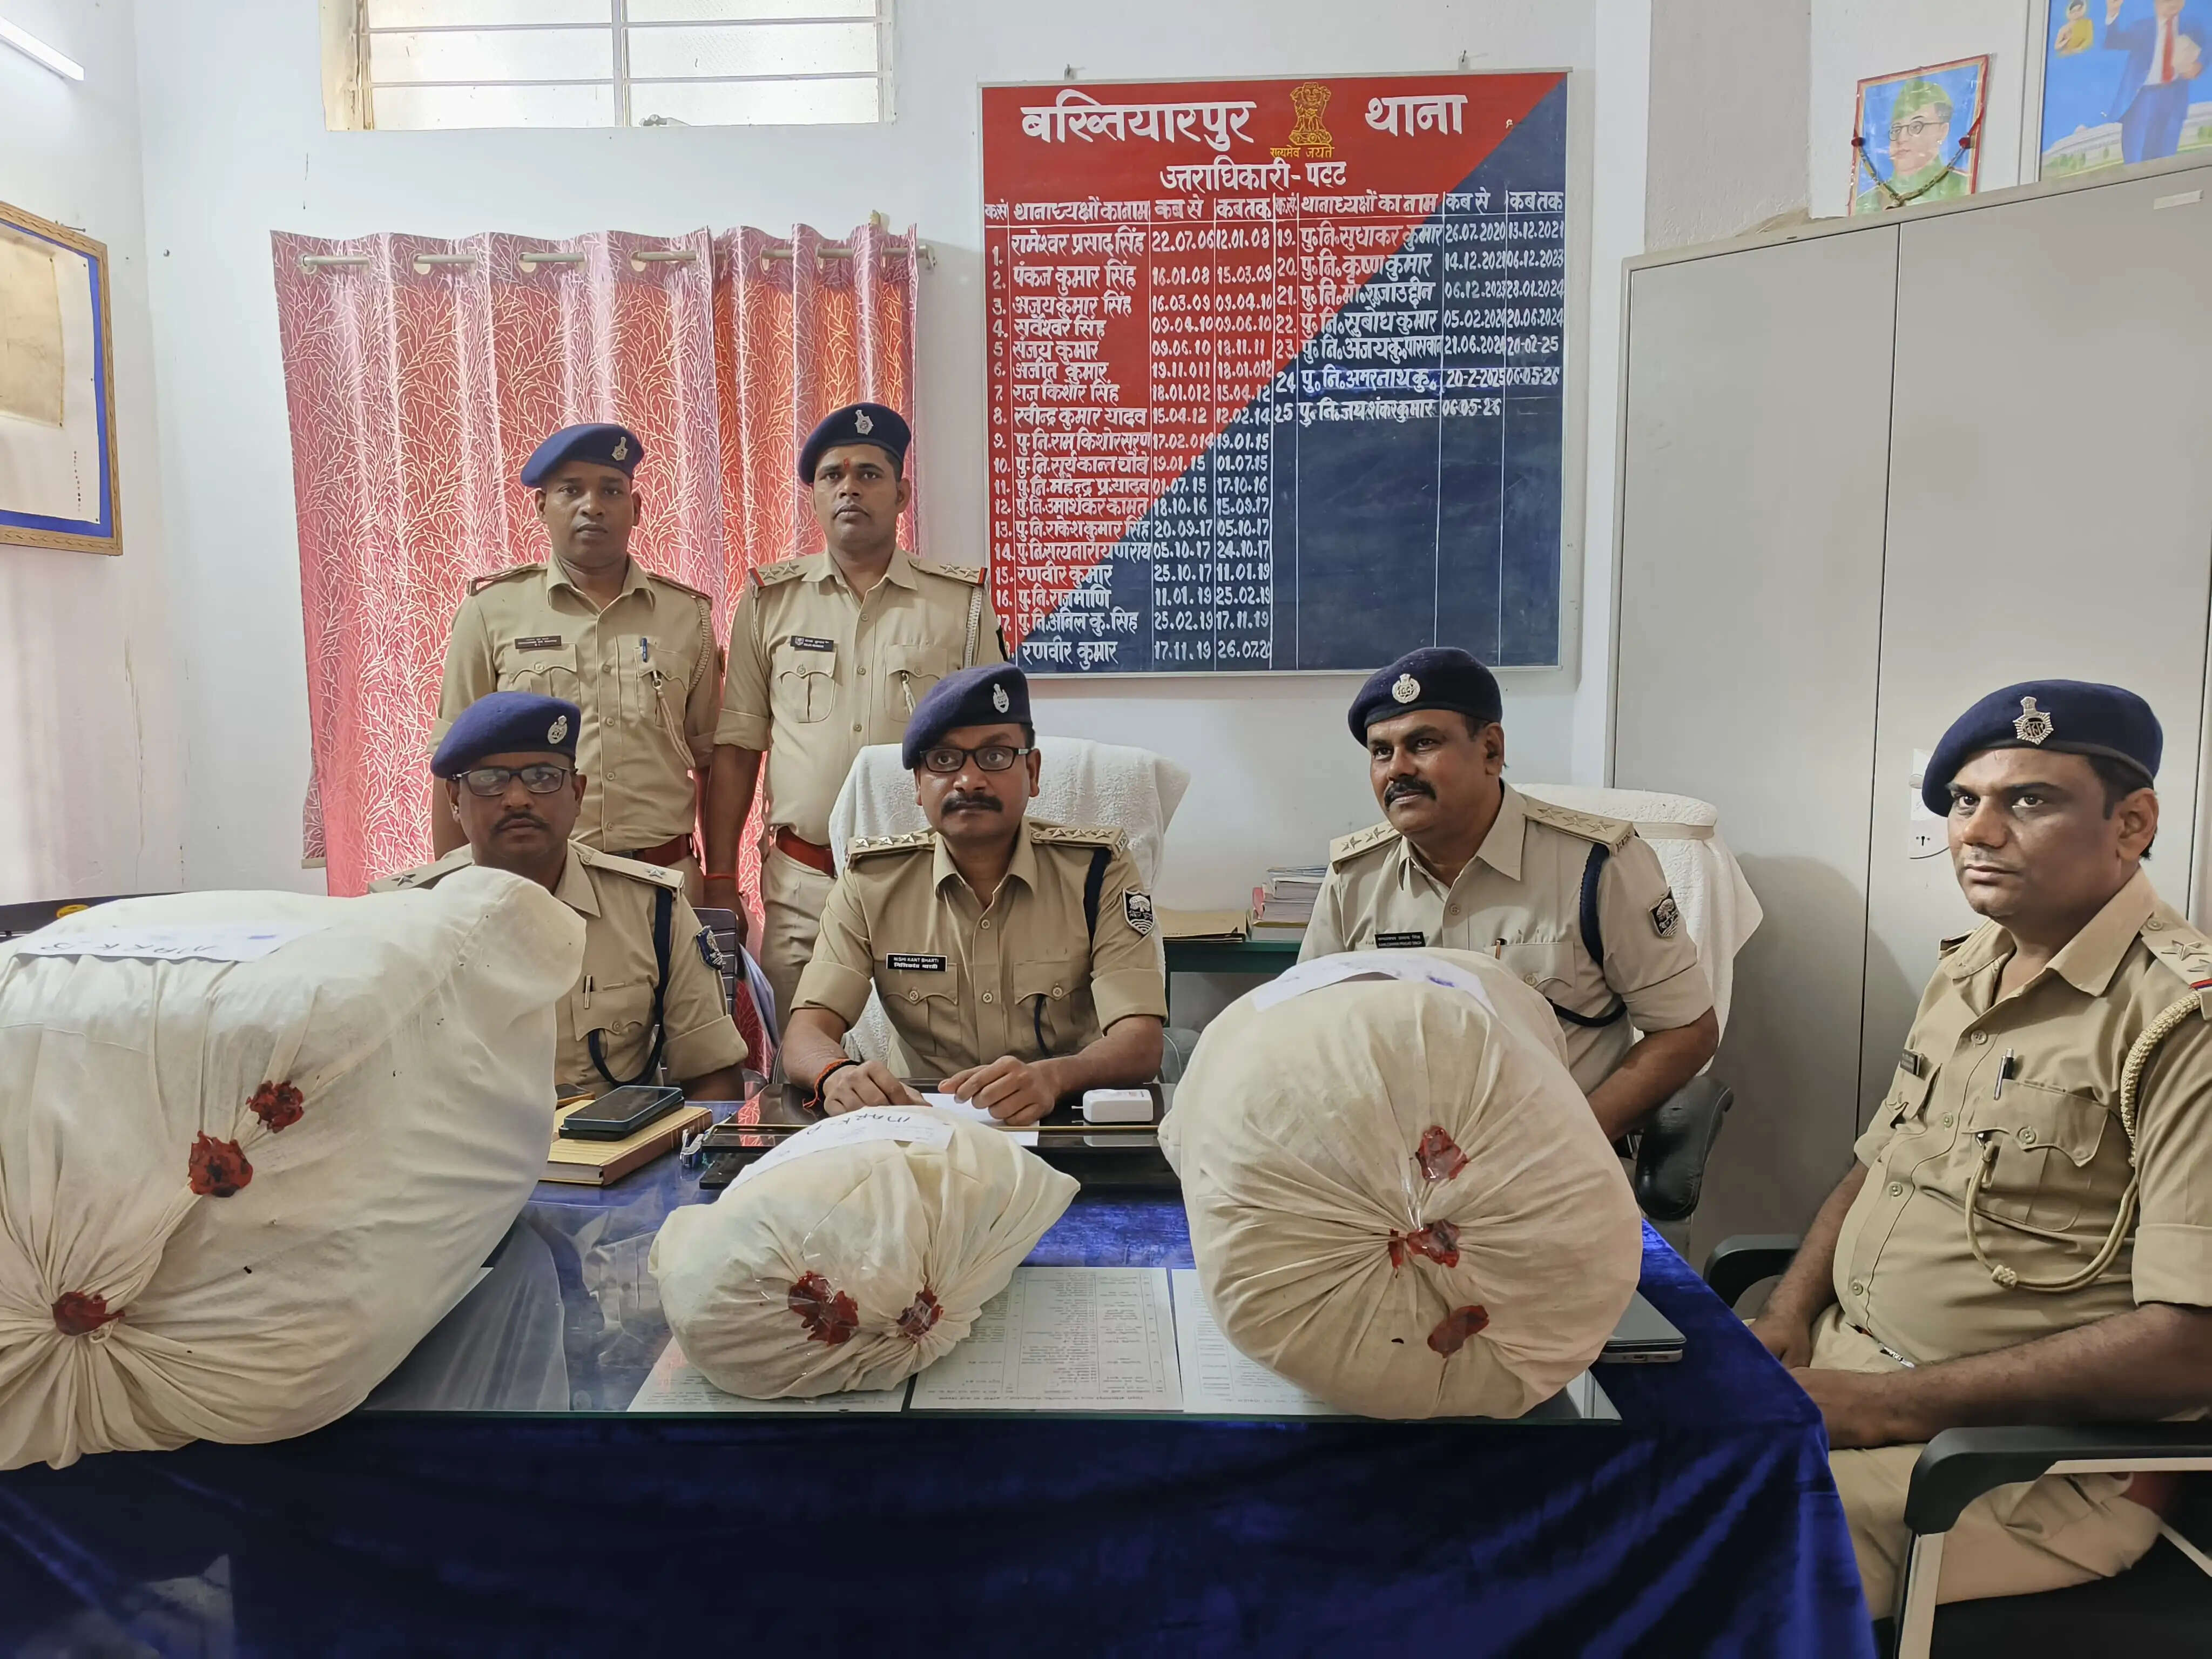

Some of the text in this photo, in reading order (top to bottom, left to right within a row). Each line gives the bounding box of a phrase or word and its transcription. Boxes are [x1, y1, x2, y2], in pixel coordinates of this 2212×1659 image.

[1365, 95, 1468, 137] थाना
[1305, 145, 1335, 158] जयते
[1155, 199, 1185, 220] कब
[1187, 193, 1204, 220] से
[1378, 194, 1402, 213] का
[1402, 193, 1439, 213] नाम
[1446, 193, 1473, 212] कब
[1475, 186, 1491, 214] से
[1509, 191, 1537, 212] कब
[1537, 191, 1564, 212] तक
[992, 225, 1270, 267] 1. रामेश्वर प्रसाद सिंह 22.07.06 12.01.08
[1277, 228, 1296, 248] 19.
[1402, 224, 1445, 252] कुमार
[1445, 221, 1506, 243] 26.07.2020
[1508, 220, 1564, 239] 13.12.2021
[993, 258, 1272, 297] 2. पंकज कुमार सिंह 16.01.08 15.03.09
[1277, 257, 1297, 277] 20.
[1385, 254, 1433, 282] कुमार
[1445, 251, 1506, 272] 14.12.2021
[1506, 249, 1564, 269] 06.12.2023
[992, 289, 1272, 320] 3. अजय कुमार सिंह 16.03.09 09.04.10
[1277, 285, 1296, 306] 21.
[1445, 280, 1506, 300] 06.12.2023
[1507, 279, 1564, 300] 28.01.2024
[993, 319, 1008, 338] 4.
[1152, 315, 1213, 334] 09.04.10
[1215, 315, 1272, 333] 09.06.10
[1276, 314, 1296, 334] 22.
[1396, 310, 1439, 335] कुमार
[1444, 308, 1506, 328] 05.02.2024
[1507, 308, 1563, 328] 20.06.2024
[1012, 336, 1054, 361] संजय
[1055, 341, 1100, 366] कुमार
[1152, 339, 1211, 356] 09.06.10
[1276, 339, 1297, 359] 23.
[994, 356, 1272, 385] 6. अजीत कुमार 19.11.011 18.01.012
[1276, 371, 1296, 394] 24
[1446, 369, 1506, 388] 20-2-2025
[1013, 385, 1040, 402] राज
[1040, 378, 1087, 403] किशोर
[1090, 379, 1120, 407] सिंह
[1152, 383, 1211, 402] 18.01.012
[1217, 383, 1270, 403] 15.04.12
[993, 401, 1271, 431] 8. रवीन्द्र कुमार यादव 15.04.12 12.02.14
[1274, 402, 1294, 422] 25
[993, 433, 1007, 449] 9.
[1153, 432, 1214, 451] 17.02.014
[1216, 433, 1269, 451] 19.01.15
[994, 457, 1011, 474] 10.
[1152, 455, 1205, 472] 19.01.15
[1217, 455, 1268, 471] 01.07.15
[994, 479, 1010, 495] 11.
[1152, 477, 1206, 495] 01.07.15
[1217, 476, 1268, 495] 17.10.16
[994, 498, 1011, 515] 12.
[1154, 496, 1208, 517] 18.10.16
[1217, 496, 1269, 516] 15.09.17
[995, 521, 1012, 538] 13.
[1084, 521, 1123, 543] कुमार
[1123, 515, 1151, 540] सिंह
[1154, 519, 1213, 538] 20.09.17
[1217, 518, 1269, 537] 05.10.17
[995, 543, 1015, 561] 14.
[1154, 541, 1211, 559] 05.10.17
[1217, 540, 1269, 561] 24.10.17
[995, 561, 1270, 589] 15. रणवीर कुमार 25.10.17 11.01.19
[996, 589, 1013, 608] 16.
[1155, 585, 1212, 606] 11.01.19
[1216, 586, 1270, 605] 25.02.19
[1154, 611, 1213, 630] 25.02.19
[1216, 610, 1269, 630] 17.11.19
[1021, 635, 1073, 665] रणवीर
[1076, 642, 1118, 671] कुमार
[1154, 640, 1211, 660] 17.11.19
